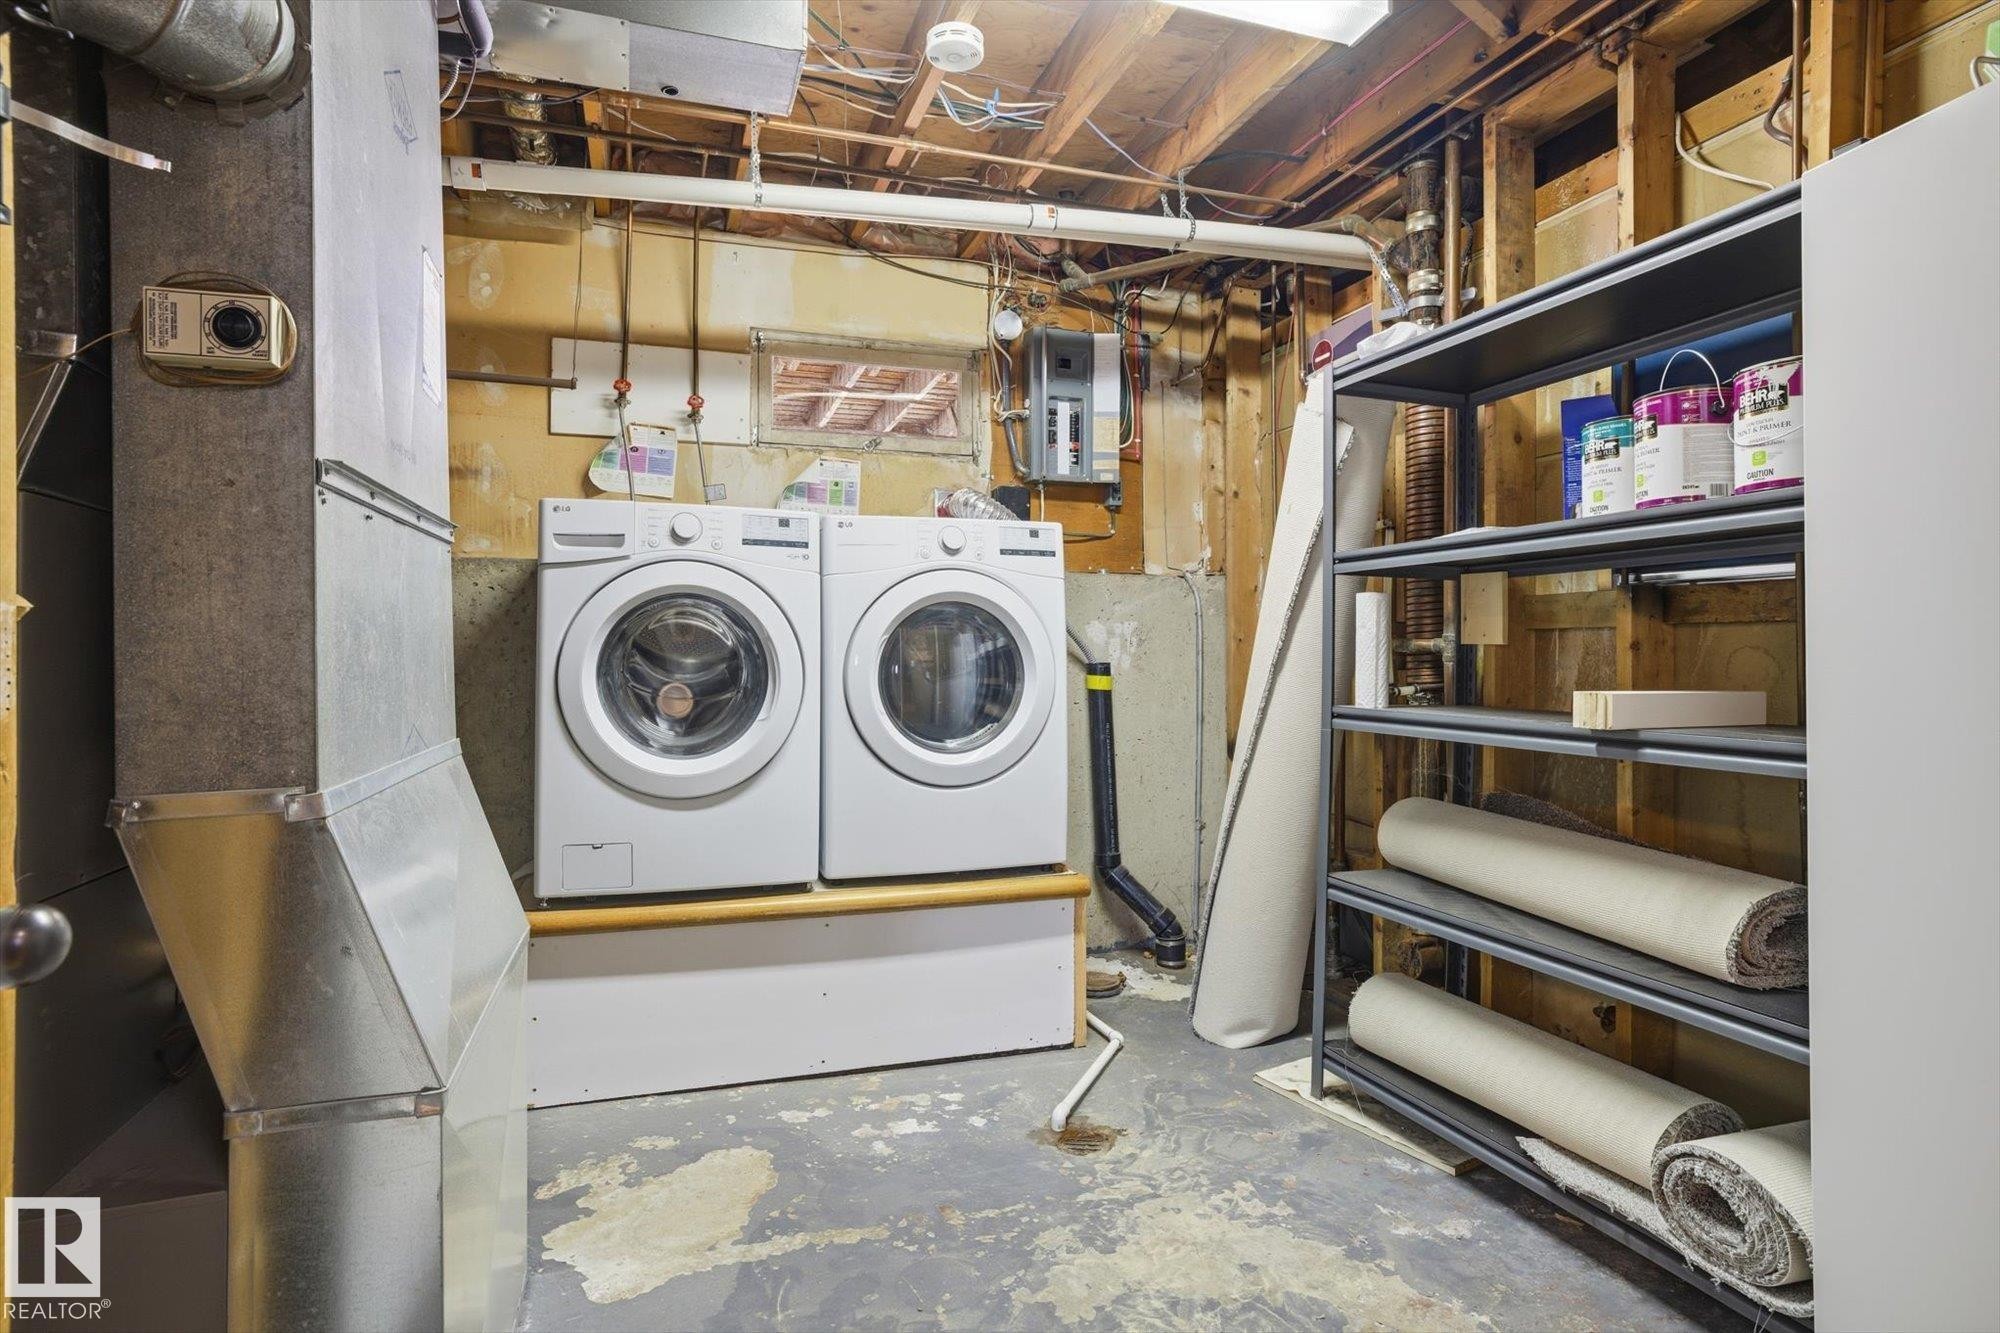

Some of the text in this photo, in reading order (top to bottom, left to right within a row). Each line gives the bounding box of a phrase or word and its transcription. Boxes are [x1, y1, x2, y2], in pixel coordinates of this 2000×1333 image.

[1739, 388, 1768, 408] BEHR
[1759, 420, 1792, 430] PRIMER
[1746, 468, 1774, 480] CAUTION
